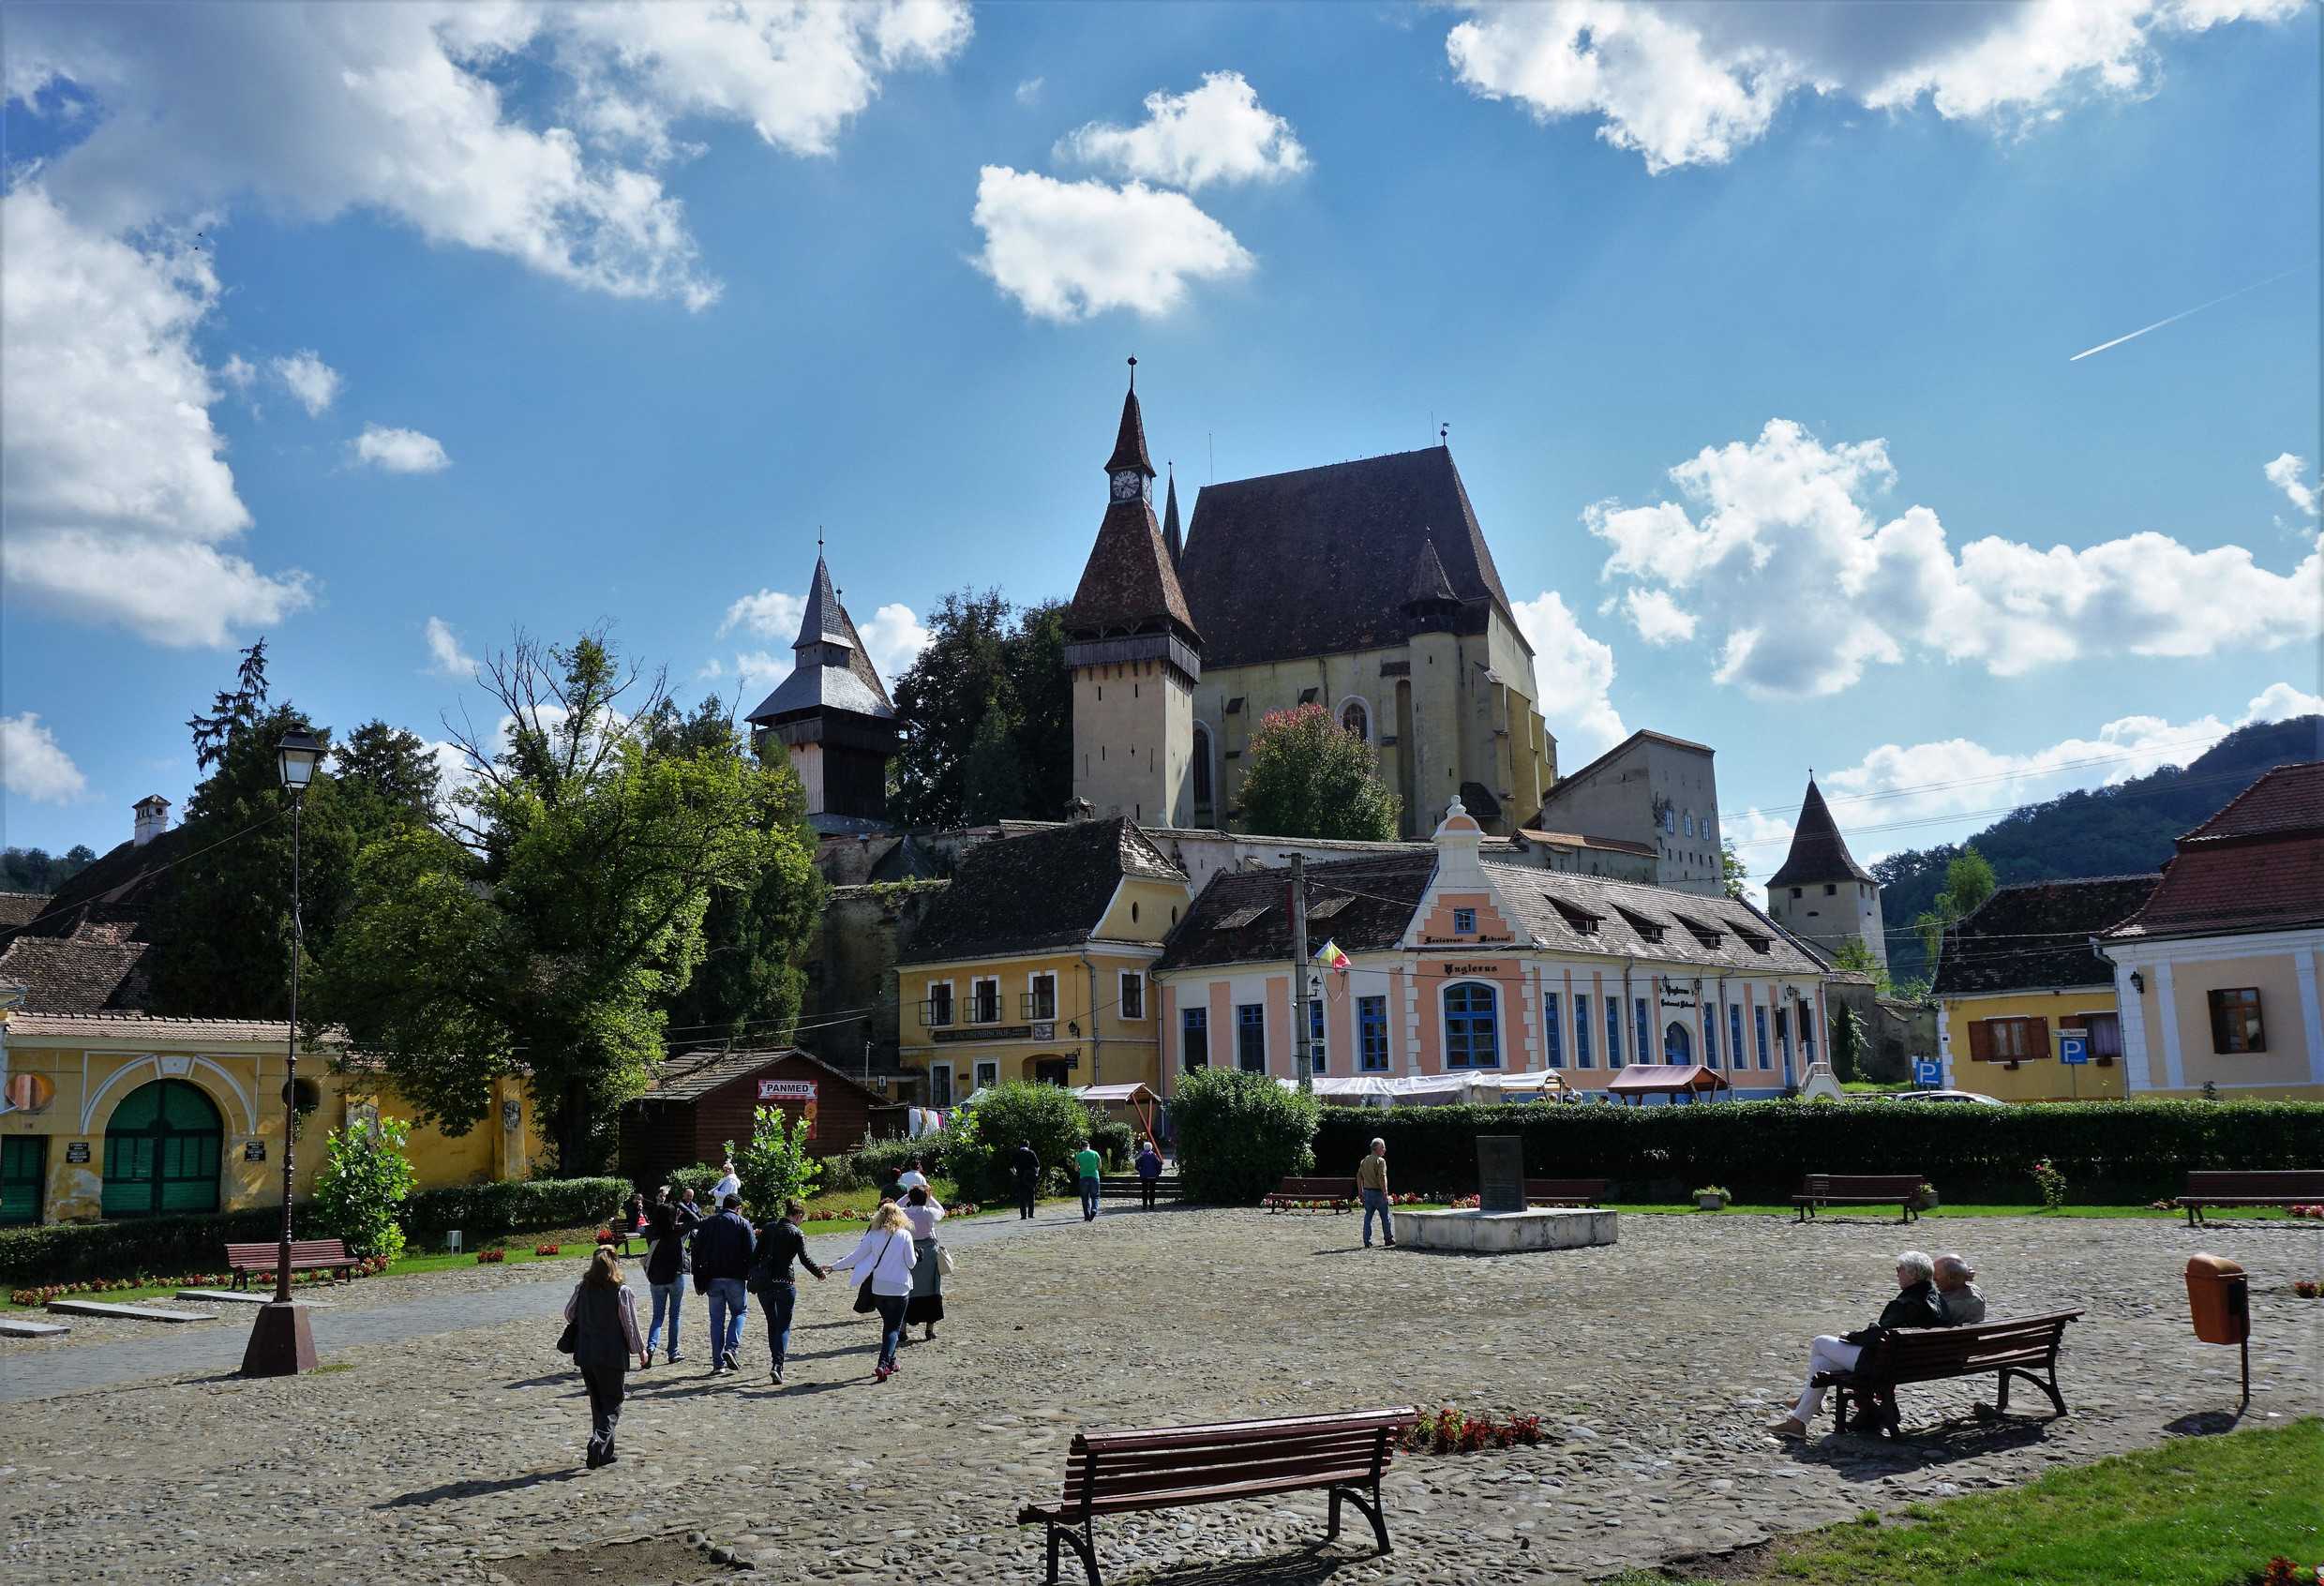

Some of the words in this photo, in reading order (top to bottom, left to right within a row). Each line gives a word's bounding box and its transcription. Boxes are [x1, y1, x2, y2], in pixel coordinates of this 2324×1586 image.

[2063, 1040, 2081, 1062] P
[1919, 1063, 1937, 1084] P
[767, 1084, 809, 1093] PANMED
